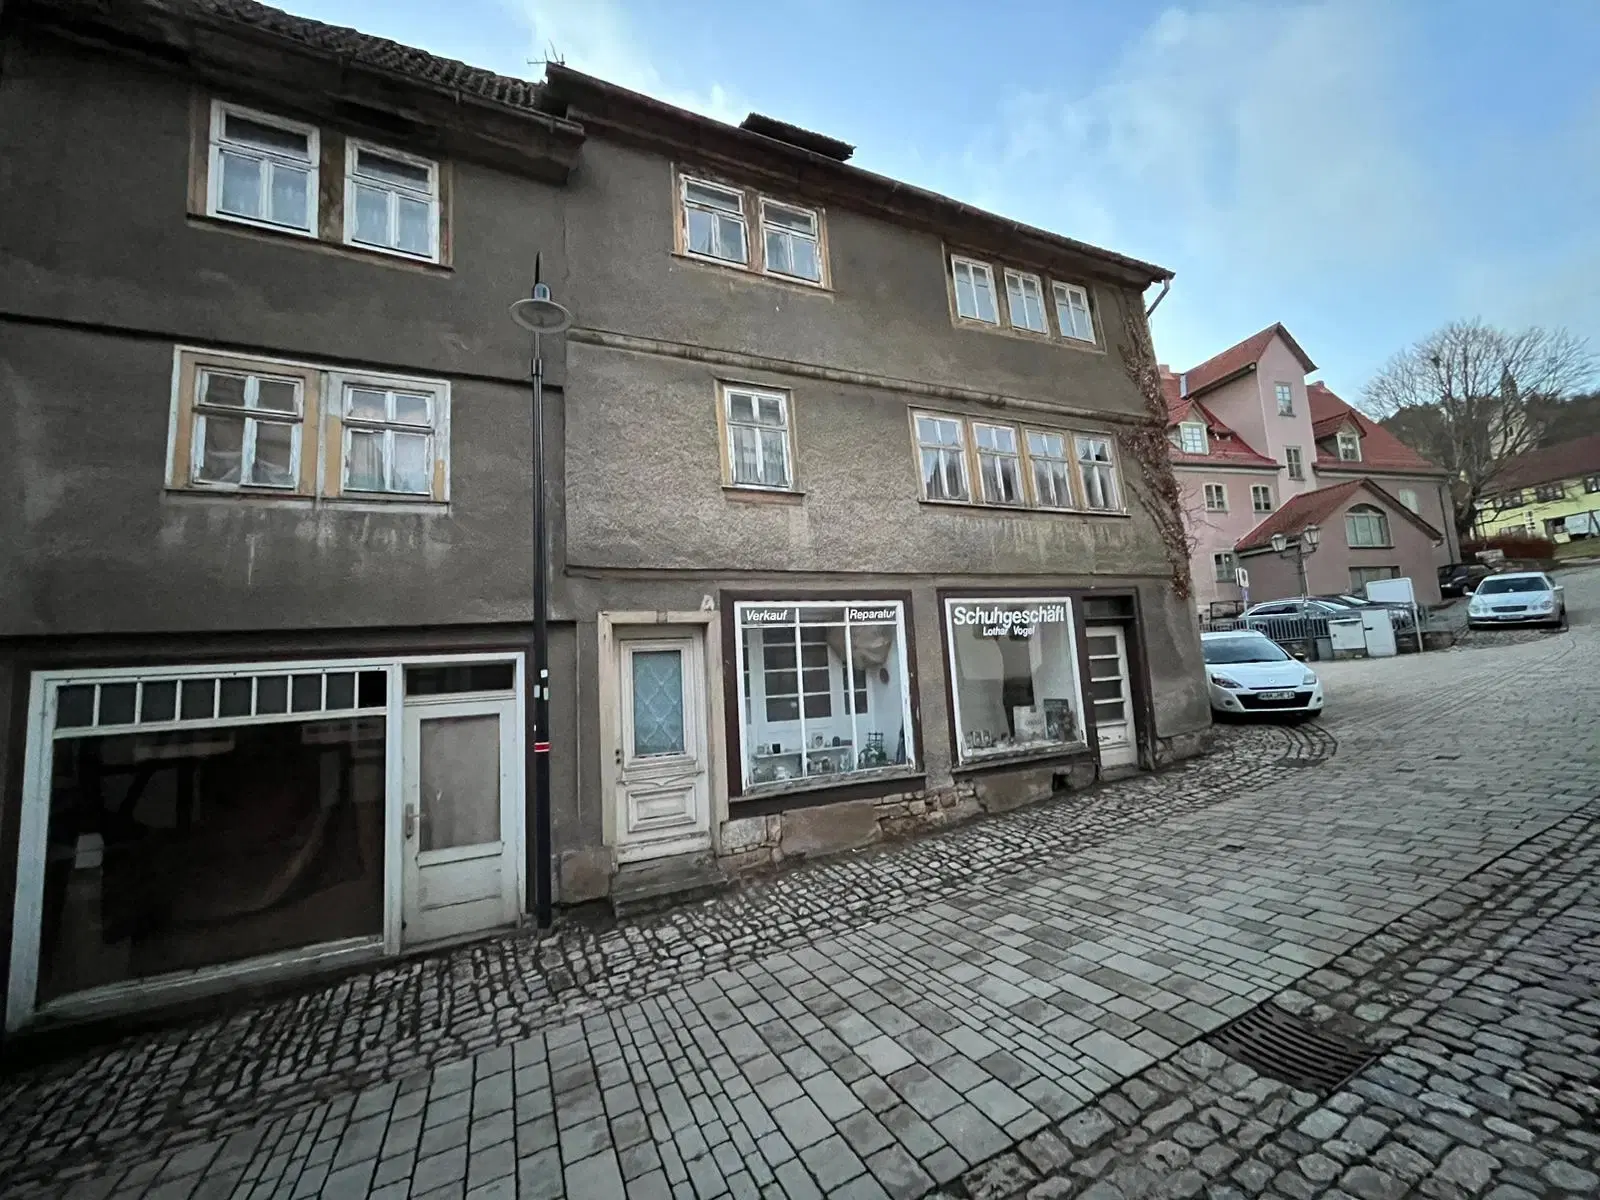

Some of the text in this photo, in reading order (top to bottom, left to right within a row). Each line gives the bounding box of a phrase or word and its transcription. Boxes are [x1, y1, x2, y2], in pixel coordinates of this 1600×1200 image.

[746, 609, 788, 621] Verkauf
[850, 609, 896, 620] Reparatur
[953, 605, 1065, 628] Schuhgeschäft
[983, 625, 1035, 637] Lothar Vogel
